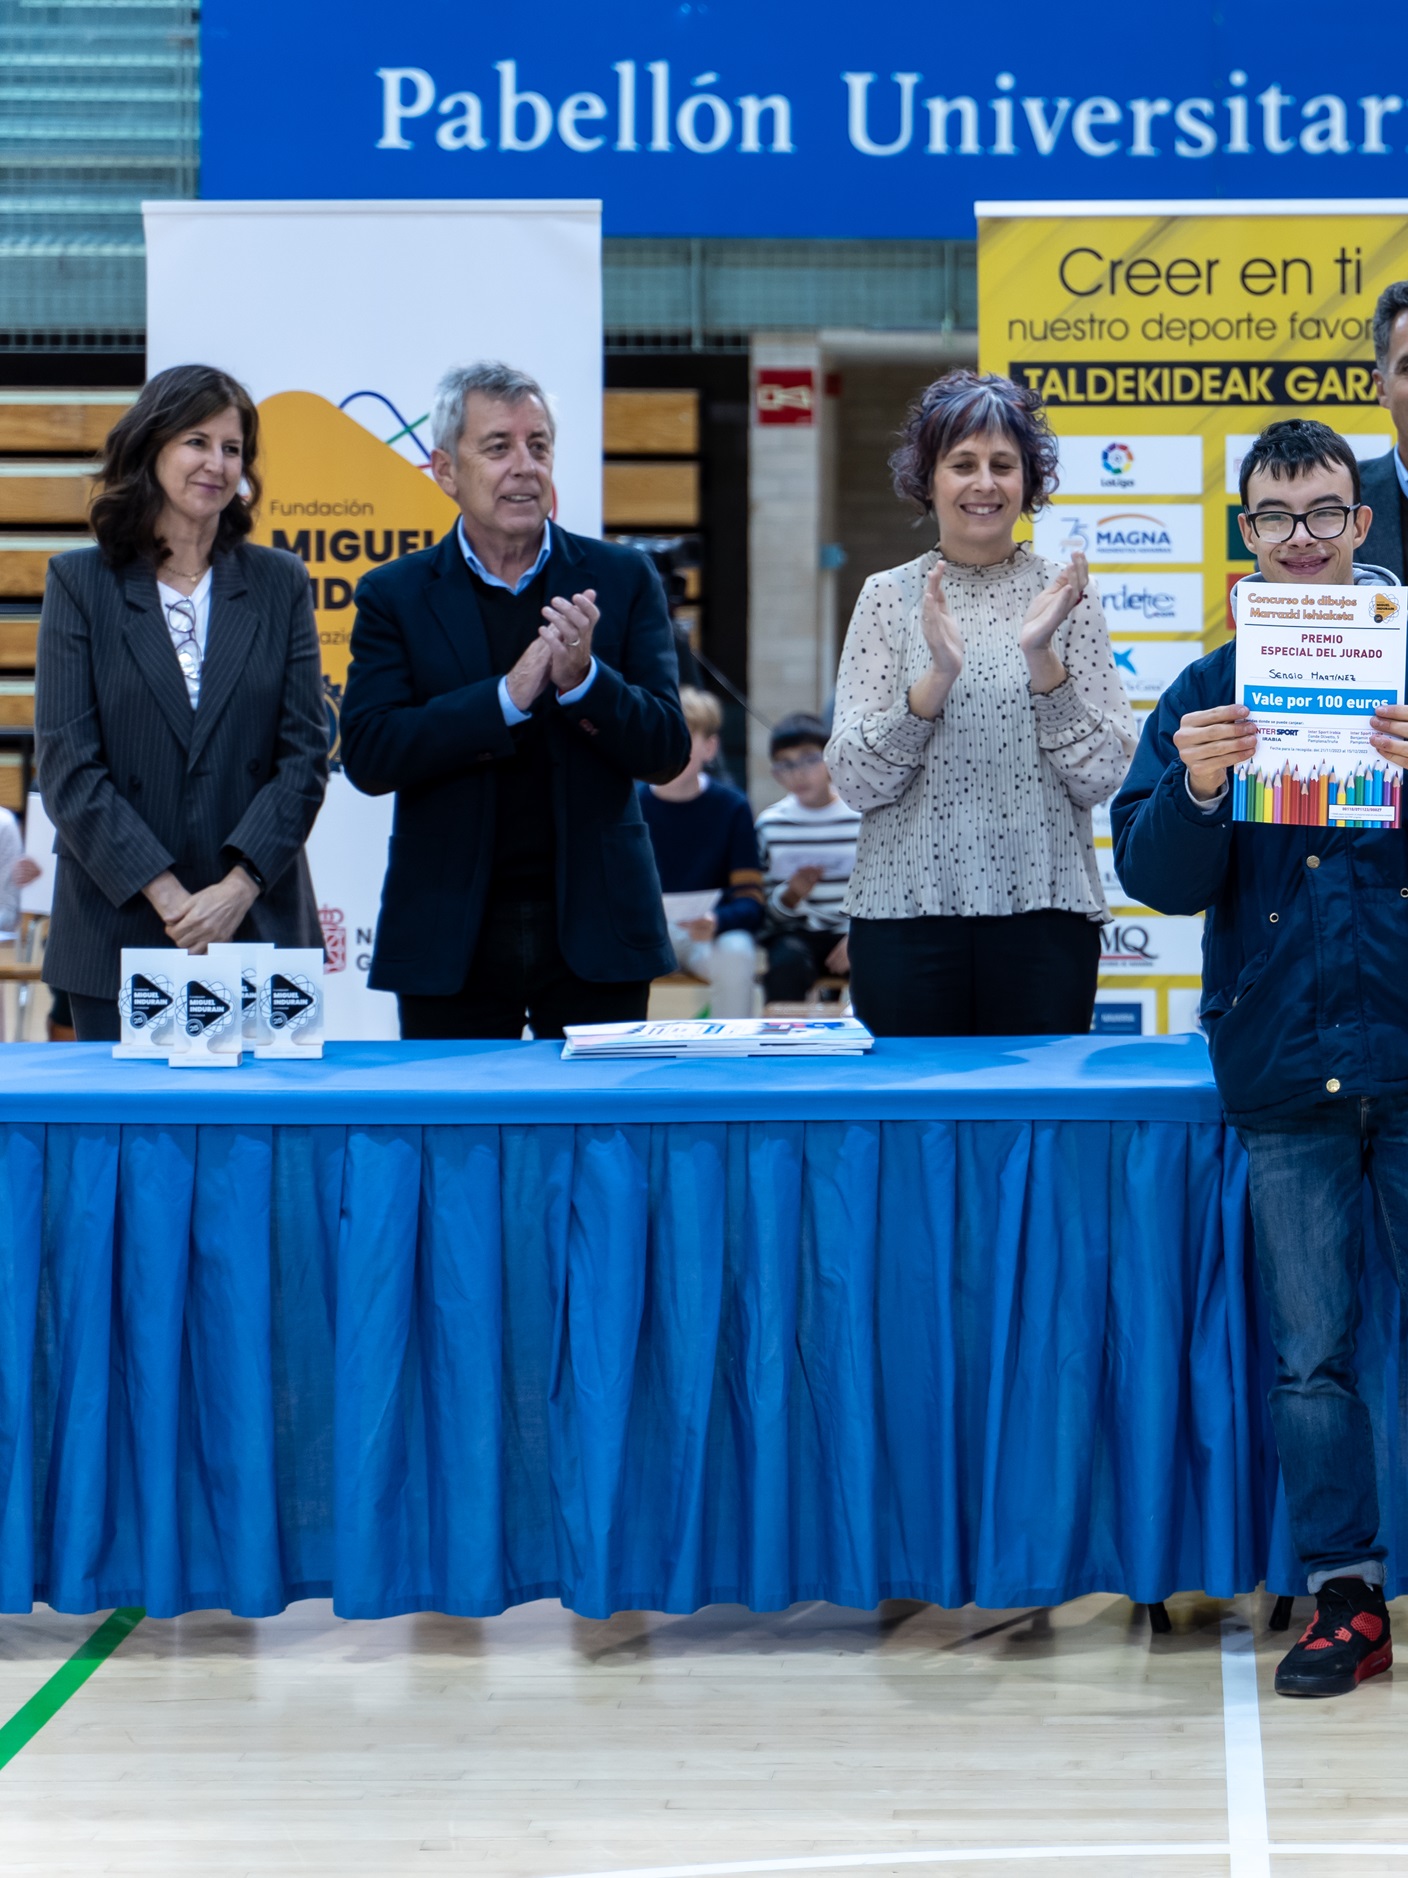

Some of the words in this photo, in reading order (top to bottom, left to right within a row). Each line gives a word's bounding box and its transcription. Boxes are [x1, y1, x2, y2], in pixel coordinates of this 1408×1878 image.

[375, 60, 797, 153] Pabellón
[1058, 246, 1220, 298] Creer
[1240, 257, 1314, 297] en
[1334, 246, 1363, 296] ti
[1008, 312, 1130, 342] nuestro
[1141, 311, 1277, 346] deporte
[1289, 311, 1374, 341] favor
[1022, 366, 1275, 402] TALDEKIDEAK
[269, 499, 374, 517] Fundación
[1096, 530, 1172, 545] MAGNA
[1247, 593, 1299, 606] Concurso
[1301, 595, 1315, 606] de
[1317, 595, 1358, 609] dibujos
[1250, 607, 1300, 620] Marrazki
[1302, 608, 1354, 621] lehiaketa
[1301, 633, 1343, 644] PREMIO
[1261, 645, 1313, 657] ESPECIAL
[1316, 648, 1337, 658] DEL
[1339, 649, 1383, 659] JURADO
[1251, 692, 1284, 706] Vale
[1286, 697, 1313, 709] por
[1316, 695, 1343, 709] 100
[1346, 698, 1389, 709] euros
[1099, 925, 1158, 959] MQ
